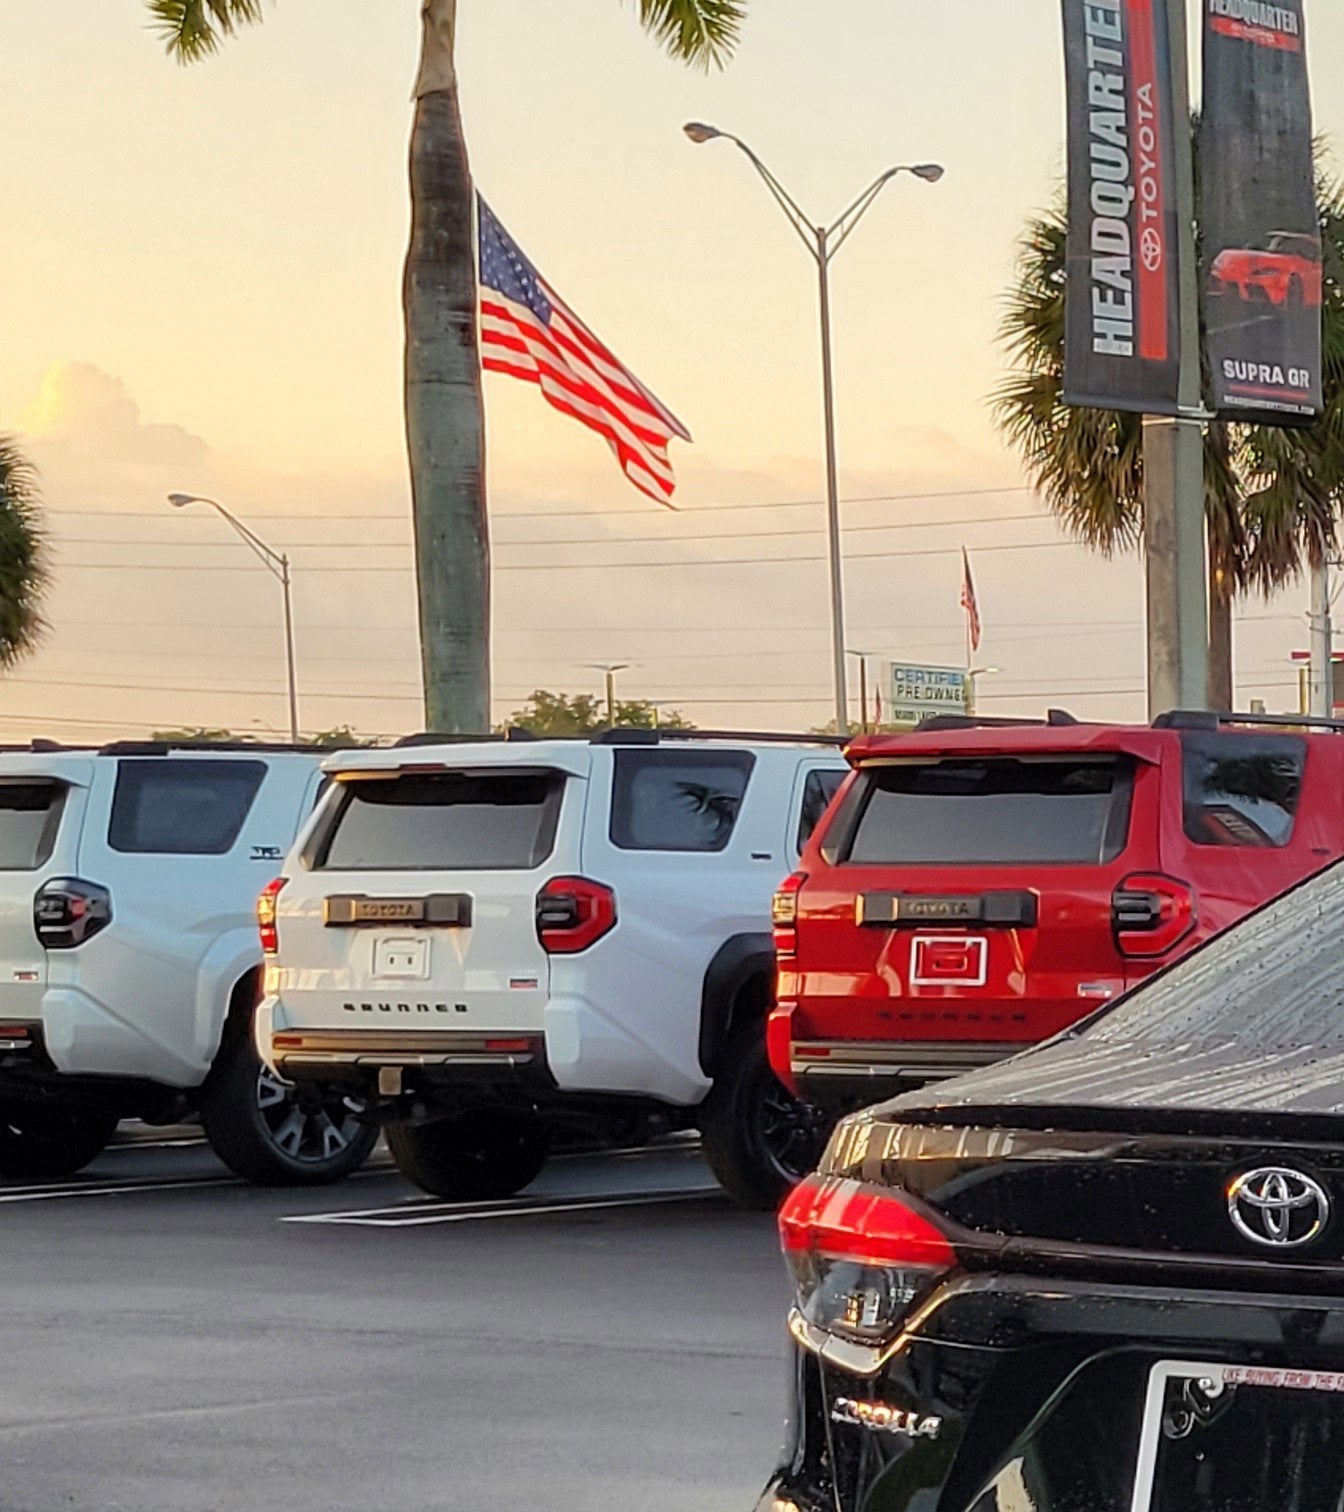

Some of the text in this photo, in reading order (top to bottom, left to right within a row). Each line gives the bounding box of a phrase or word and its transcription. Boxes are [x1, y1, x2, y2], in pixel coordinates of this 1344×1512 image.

[1084, 0, 1134, 356] HEADQUARTE
[1137, 82, 1158, 223] TOYOTA
[1223, 359, 1310, 389] SUPRA GR
